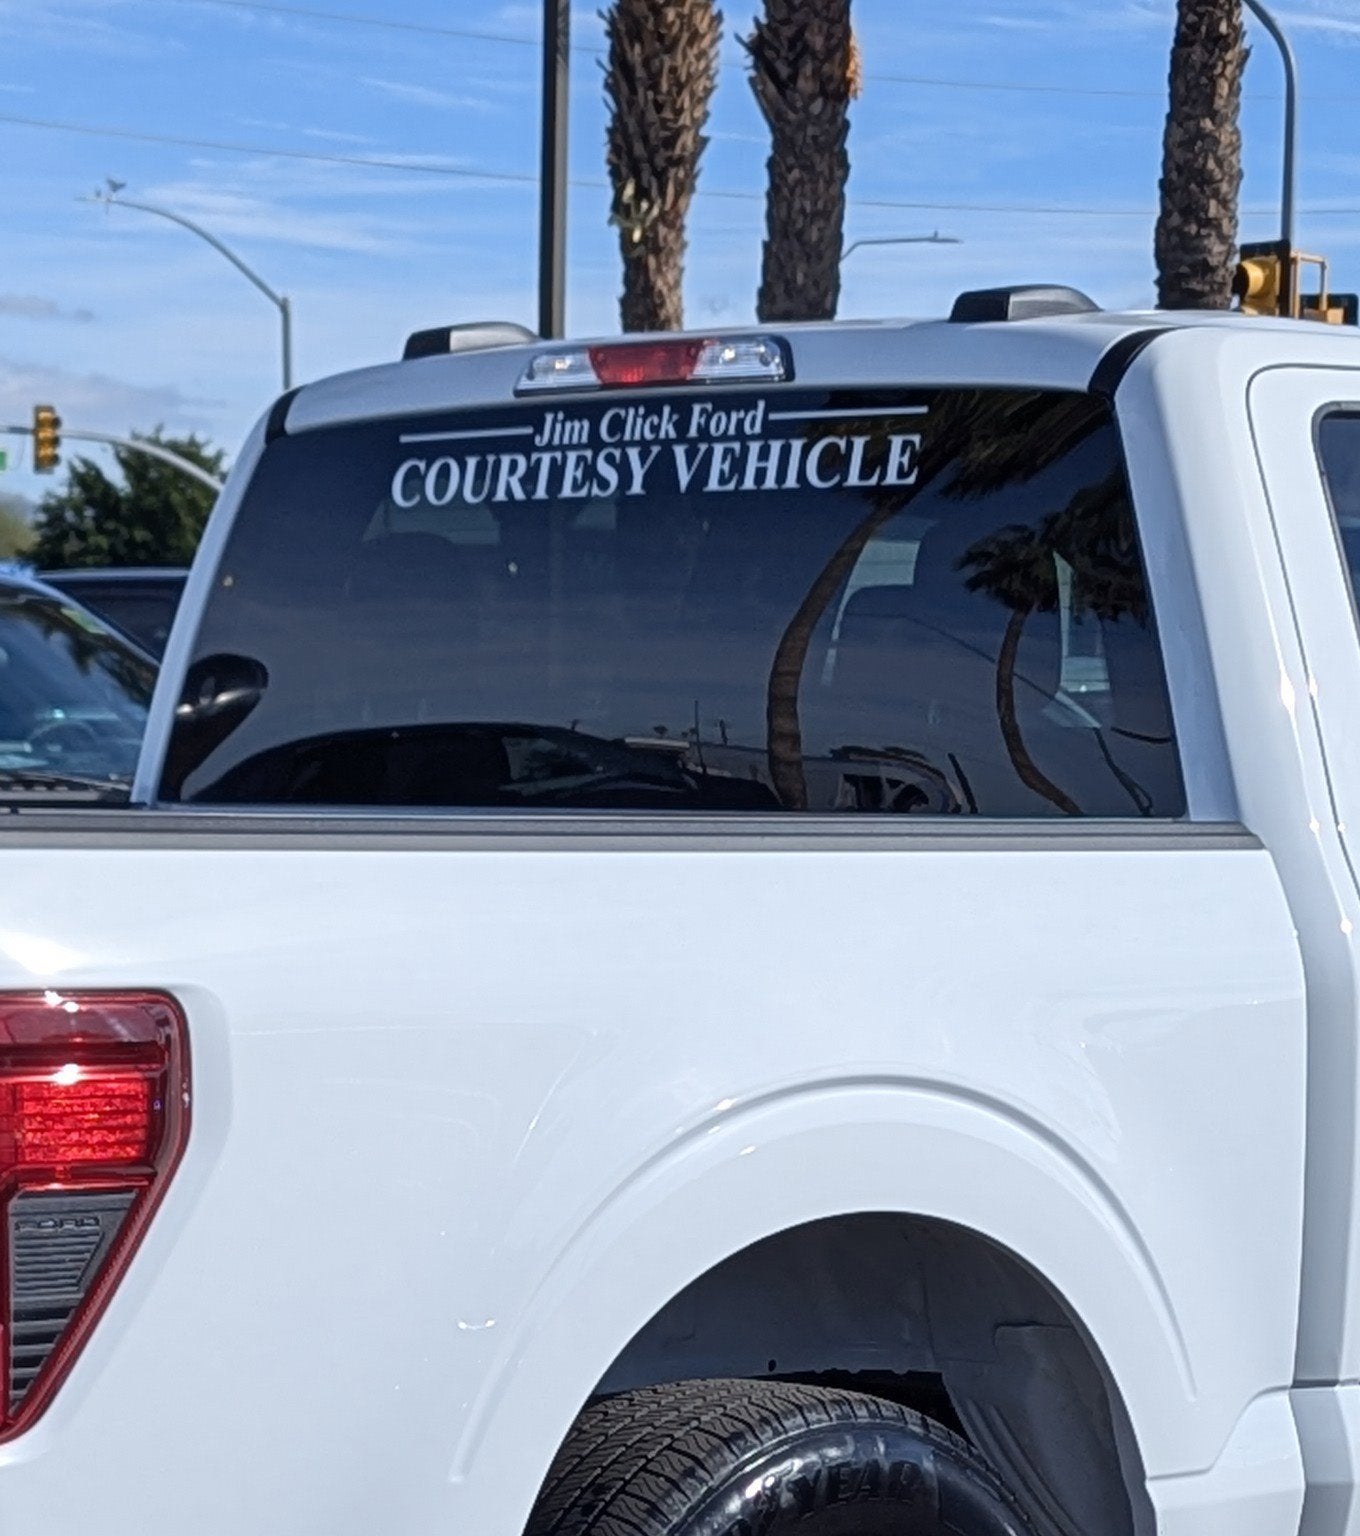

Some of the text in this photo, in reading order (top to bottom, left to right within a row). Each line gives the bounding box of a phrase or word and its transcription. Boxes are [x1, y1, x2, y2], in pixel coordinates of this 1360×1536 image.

[534, 401, 765, 446] Jim Click Ford
[391, 433, 921, 507] COURTESY VEHICLE
